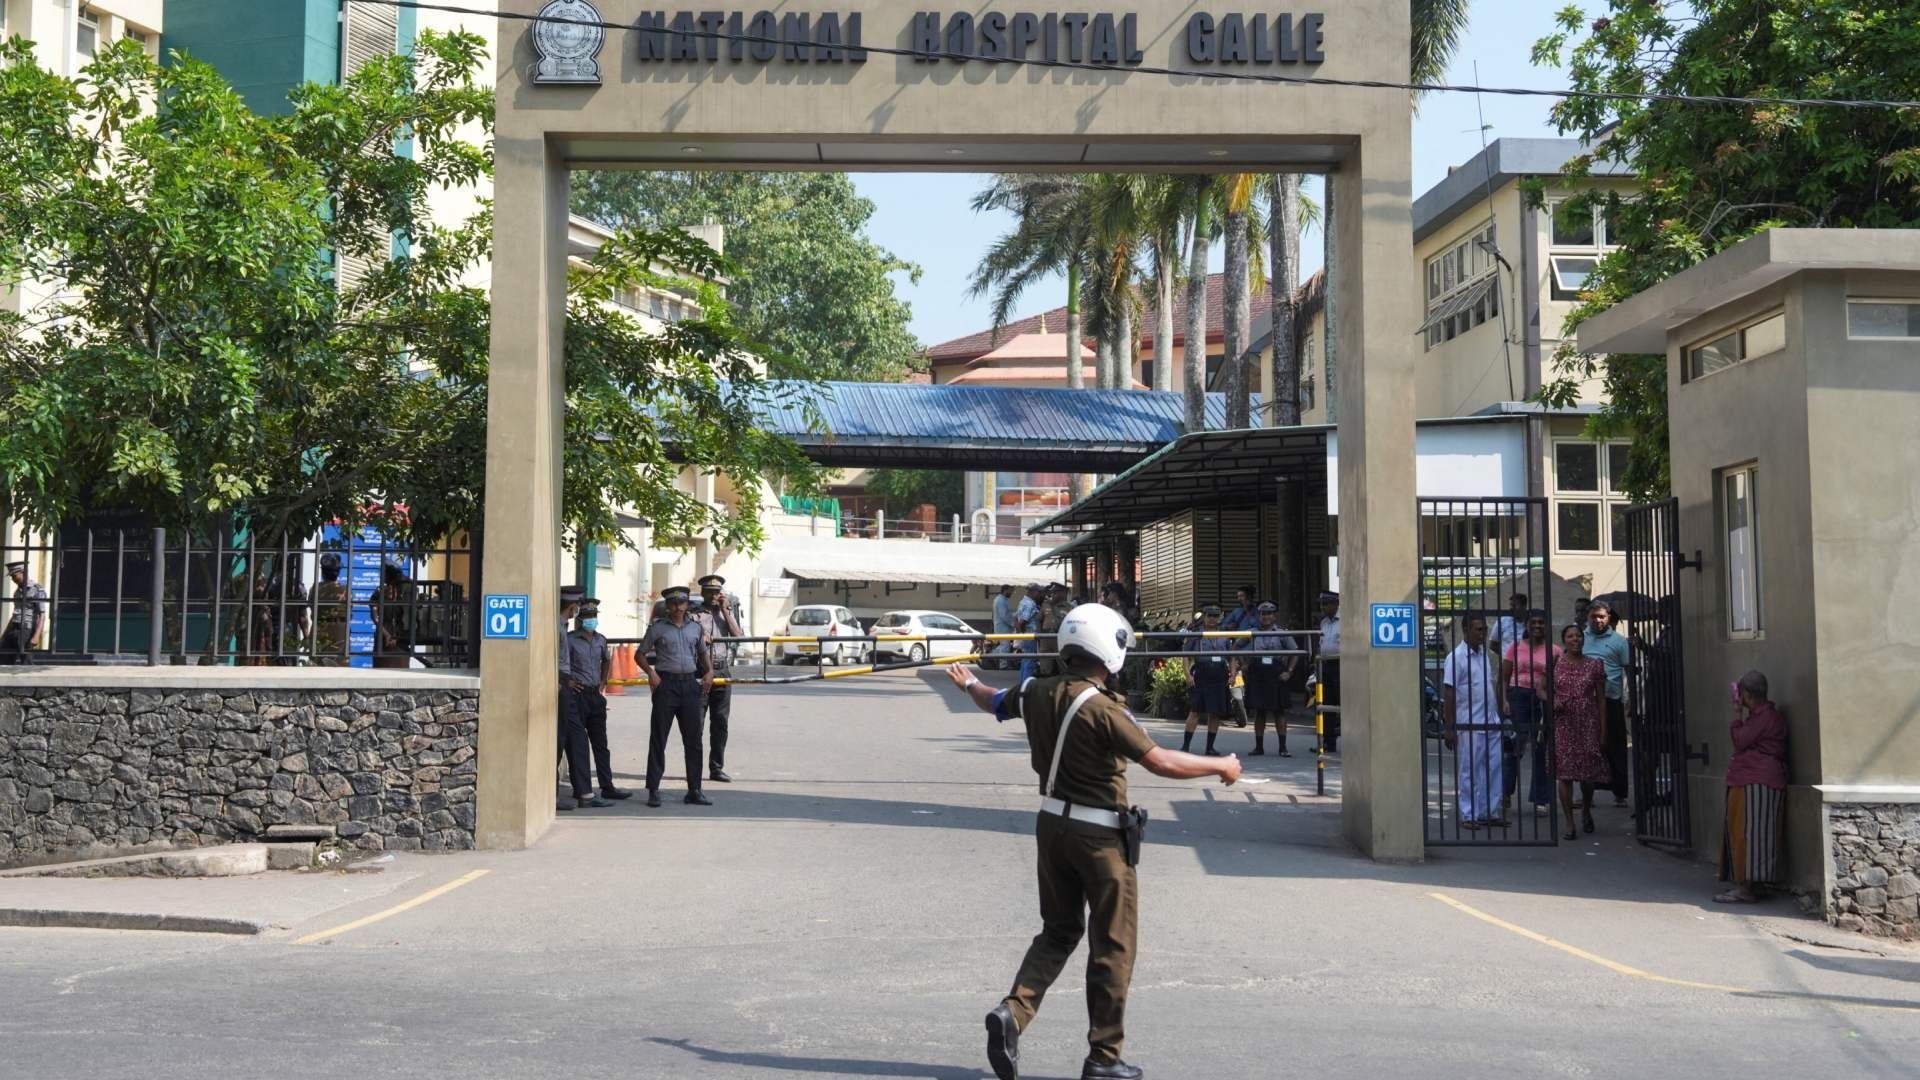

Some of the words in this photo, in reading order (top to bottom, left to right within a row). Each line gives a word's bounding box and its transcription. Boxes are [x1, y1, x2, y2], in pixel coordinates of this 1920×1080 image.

[639, 10, 867, 62] NATIONAL
[914, 11, 1143, 63] HOSPITAL
[1187, 11, 1325, 63] GALLE
[489, 598, 524, 609] GATE
[1376, 608, 1411, 618] GATE
[491, 612, 521, 634] 01
[1378, 622, 1409, 643] 01
